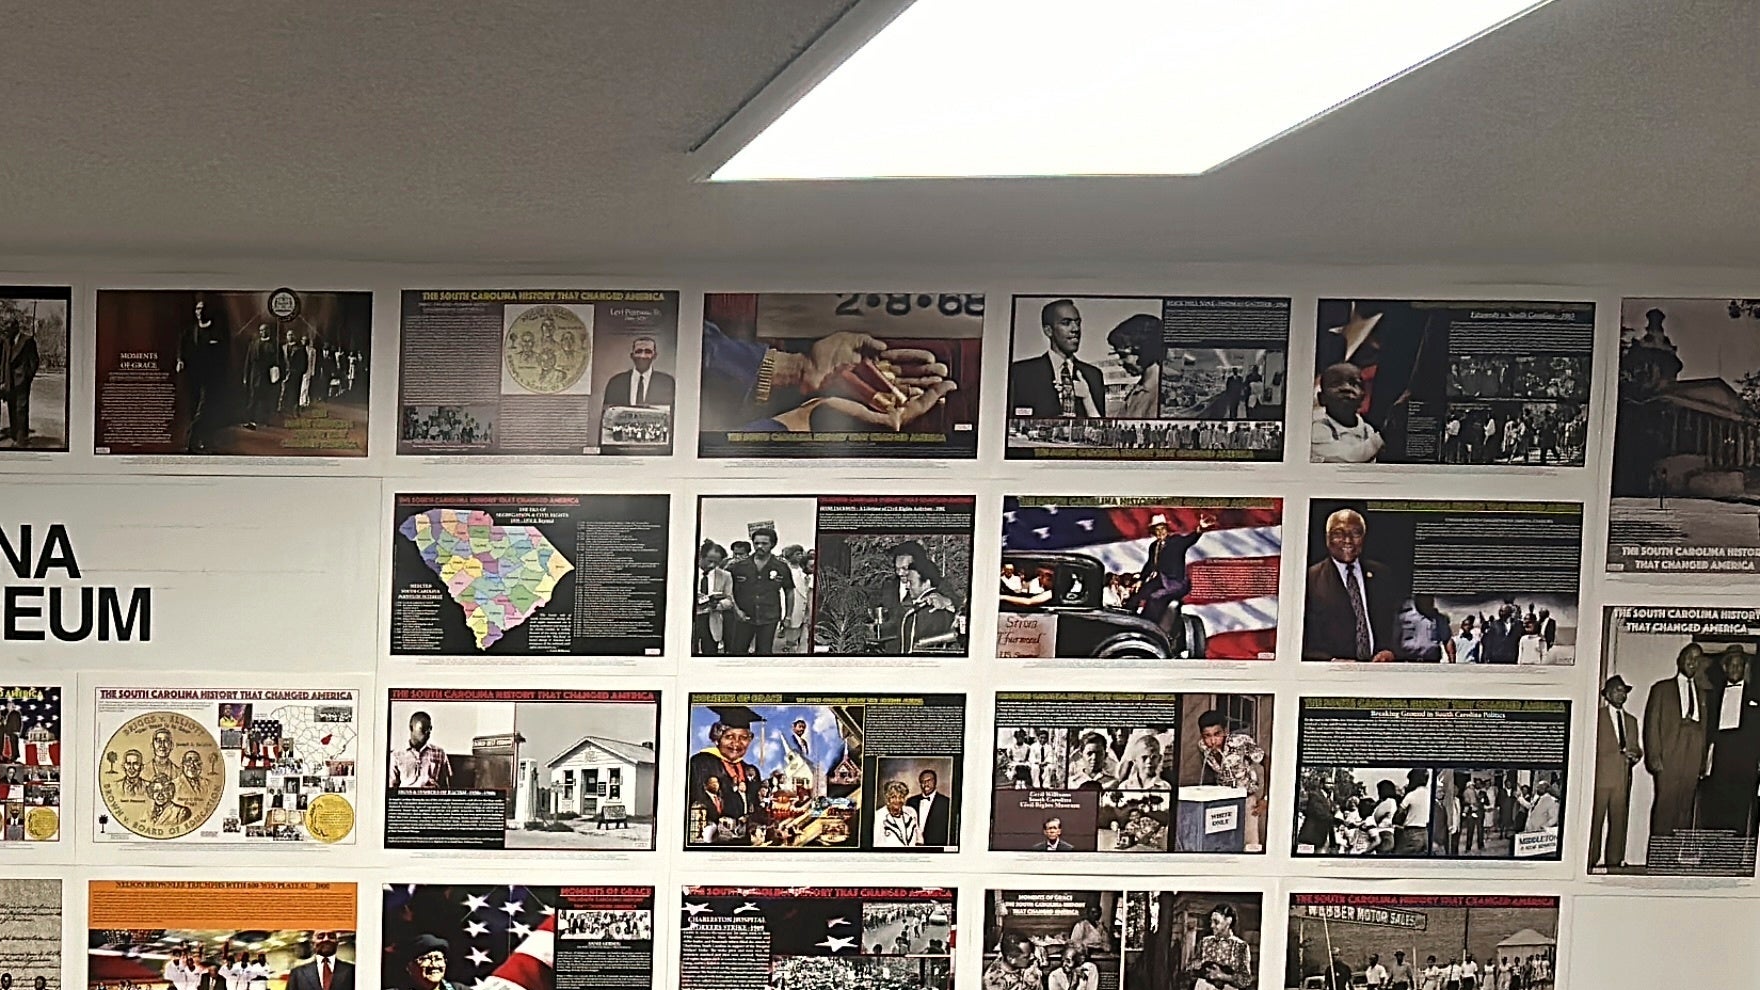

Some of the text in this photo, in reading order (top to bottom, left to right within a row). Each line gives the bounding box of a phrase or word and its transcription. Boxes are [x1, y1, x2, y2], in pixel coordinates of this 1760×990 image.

[1614, 608, 1632, 619] THE
[1633, 608, 1666, 619] SOUTH
[1667, 608, 1719, 620] CAROLINA
[1625, 622, 1748, 634] THAT CHANGED AMERICA
[100, 690, 353, 701] THE SOUTH CAROLINA HISTORY THAT CHANGED AMERICA
[122, 716, 156, 737] BRIGGS
[169, 716, 205, 736] ELLIOTT
[103, 783, 125, 816] BROWN
[132, 820, 164, 837] BOARD
[168, 827, 180, 835] OF
[185, 786, 221, 830] EDUCATION
[1357, 907, 1389, 924] MOTOR
[1390, 912, 1415, 926] SALES
